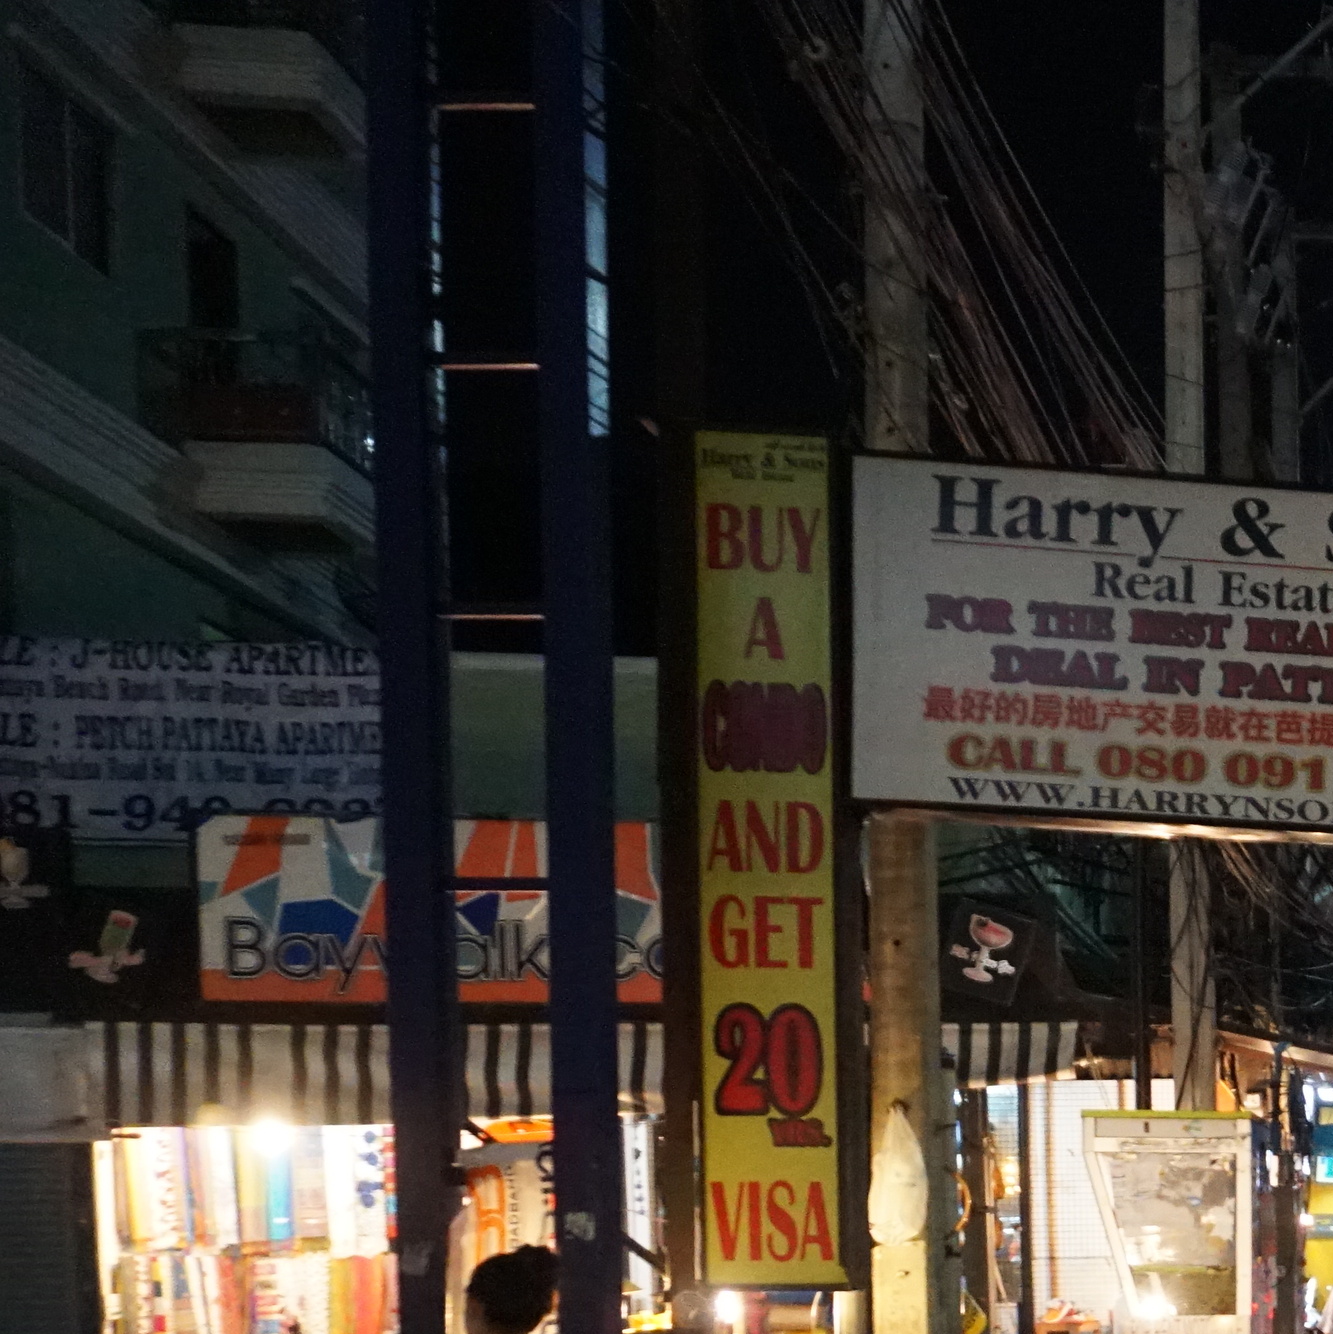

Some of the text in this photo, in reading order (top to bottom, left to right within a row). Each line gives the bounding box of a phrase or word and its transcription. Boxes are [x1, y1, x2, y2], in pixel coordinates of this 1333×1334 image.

[704, 502, 820, 574] BUY
[931, 474, 1184, 568] Harry
[1220, 497, 1285, 560] &
[1092, 561, 1195, 604] Real
[744, 597, 785, 661] A
[925, 593, 1017, 636] FOR
[1027, 601, 1116, 642] THE
[1128, 608, 1232, 650] BEST
[990, 644, 1129, 690] DEAL
[1142, 655, 1205, 697] IN
[946, 734, 1081, 778] CALL
[1095, 743, 1208, 787] 080
[1223, 750, 1328, 792] 091
[706, 801, 825, 874] AND
[708, 895, 825, 969] GET
[714, 1002, 824, 1118] 20
[710, 1180, 834, 1262] VISA
